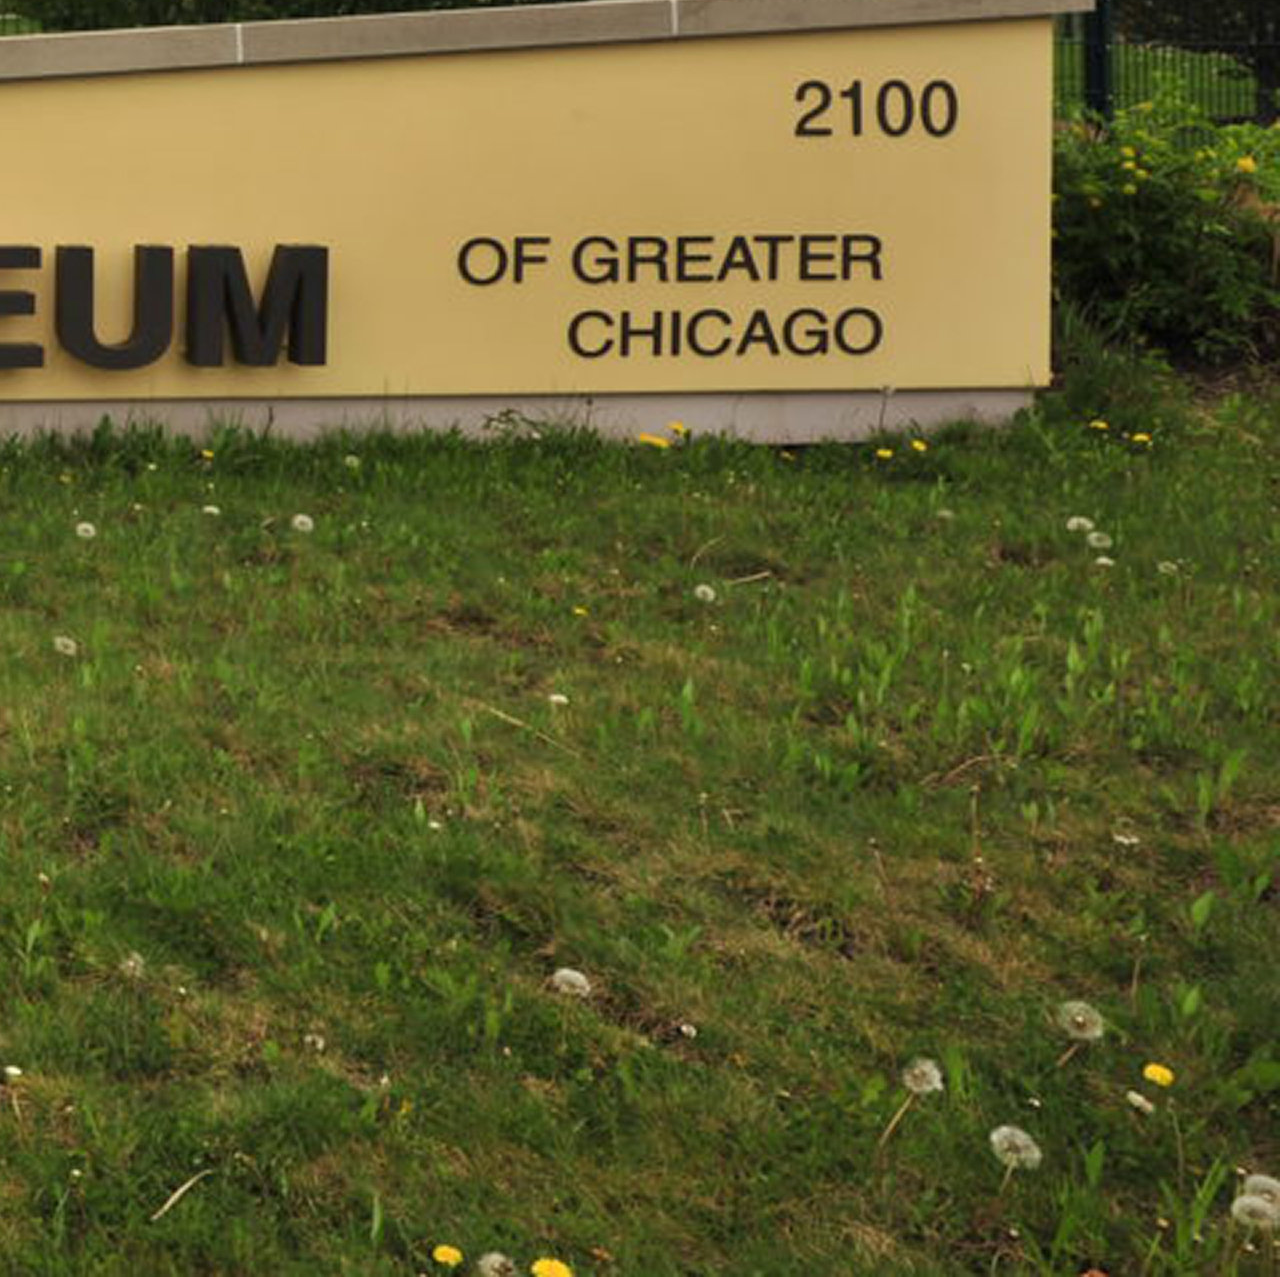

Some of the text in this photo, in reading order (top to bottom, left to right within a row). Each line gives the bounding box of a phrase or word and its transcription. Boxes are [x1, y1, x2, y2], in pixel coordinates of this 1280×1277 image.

[794, 79, 958, 138] 2100
[457, 234, 883, 287] OF GREATER
[568, 307, 883, 359] CHICAGO
